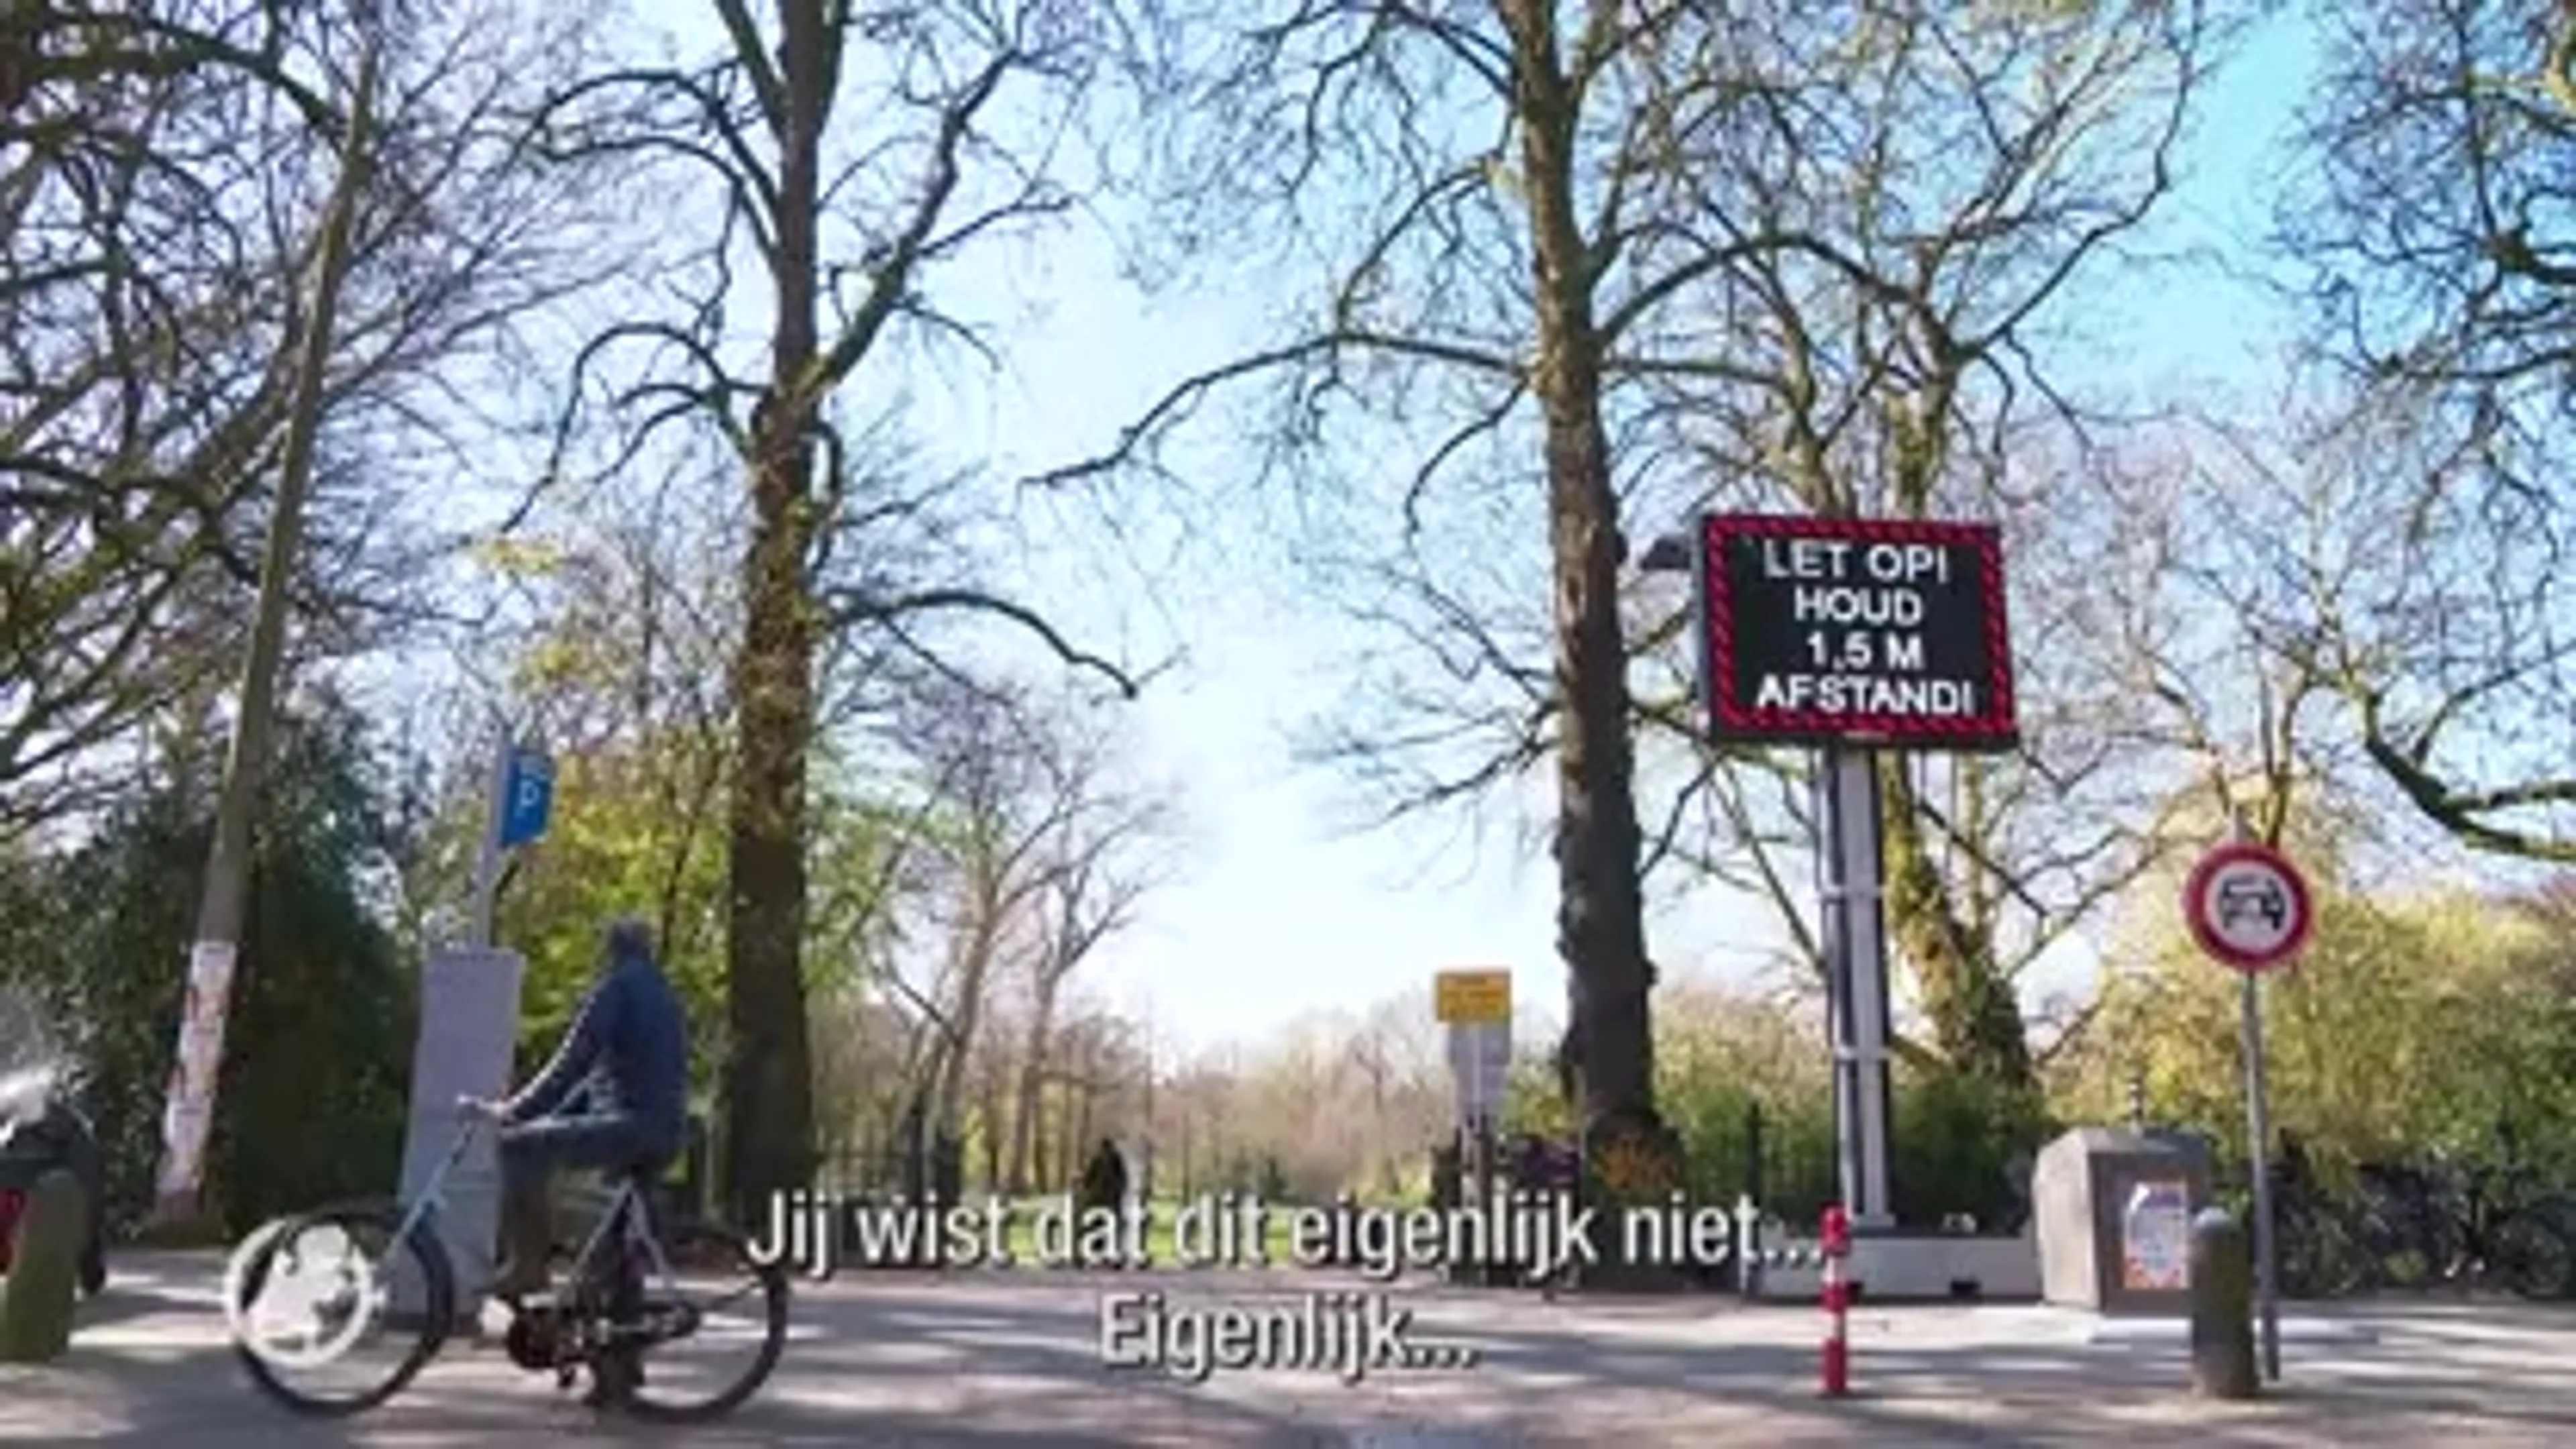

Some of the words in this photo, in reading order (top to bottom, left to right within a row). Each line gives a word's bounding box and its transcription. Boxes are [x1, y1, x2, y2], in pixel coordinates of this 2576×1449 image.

[1764, 539, 1851, 578] LET
[1793, 586, 1923, 627] HOUD
[1886, 634, 1925, 669] M
